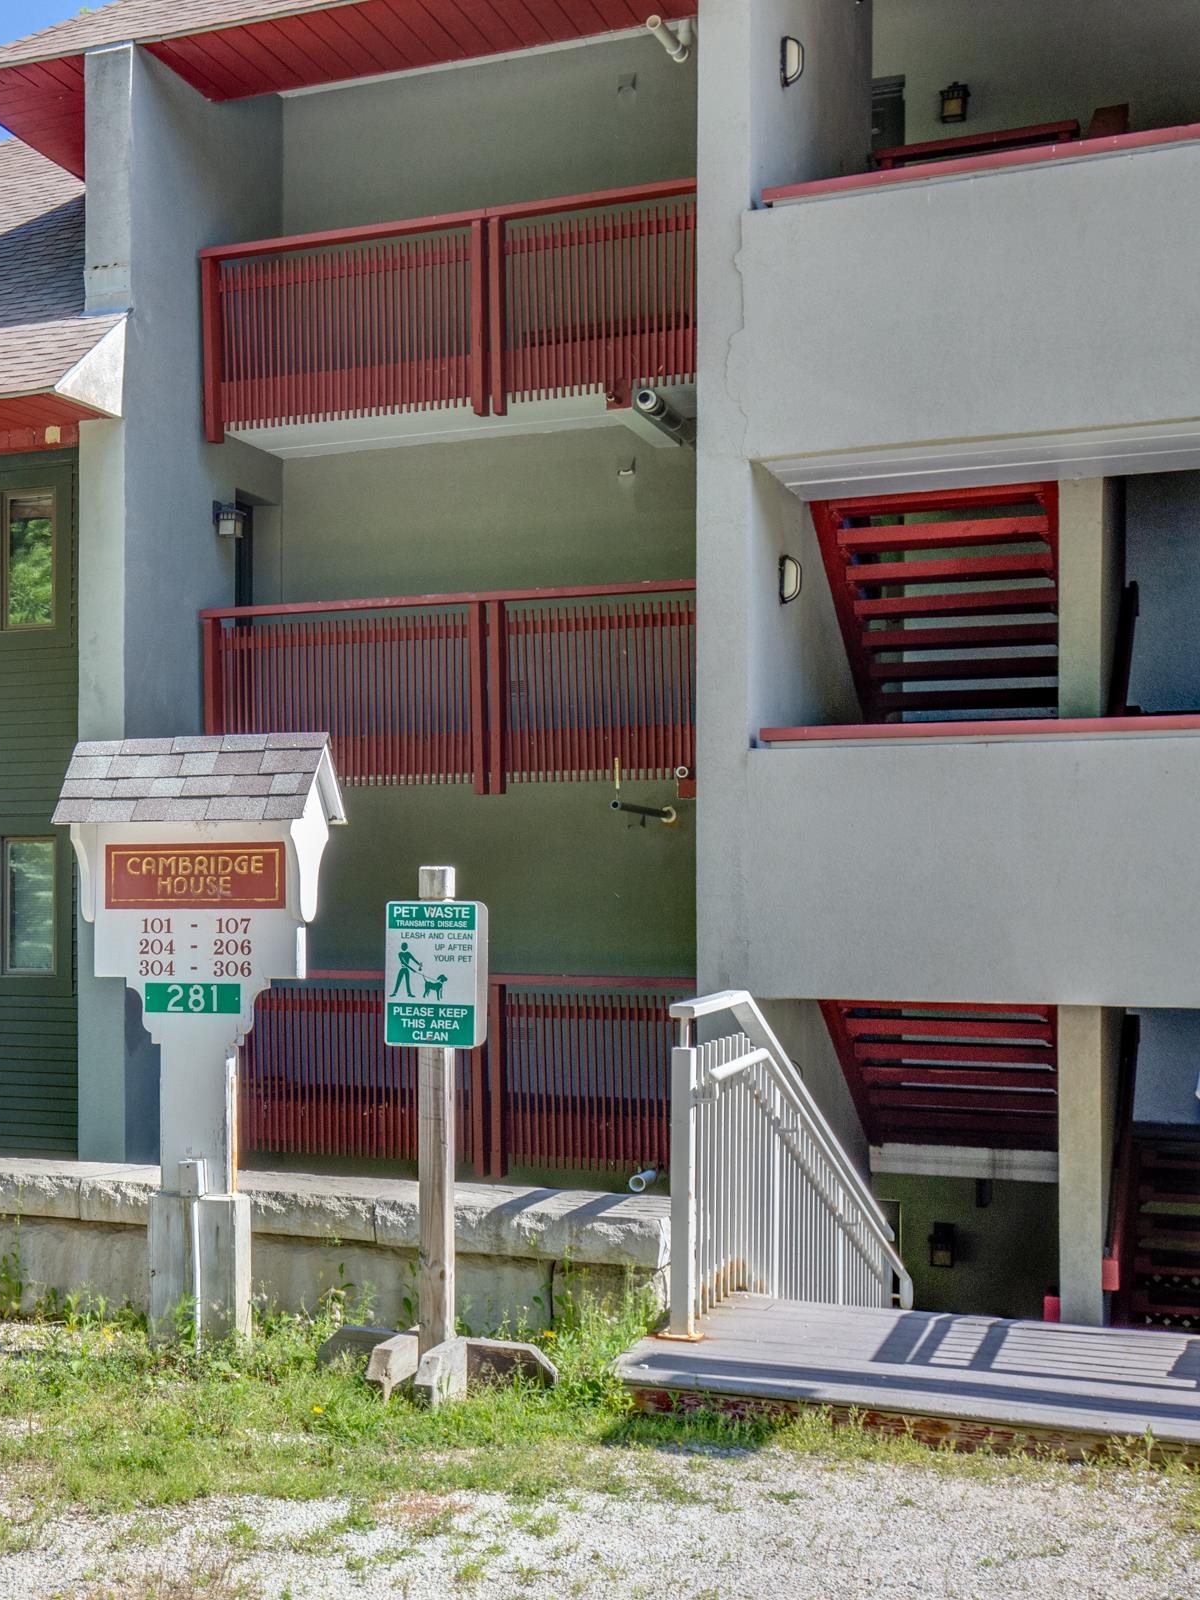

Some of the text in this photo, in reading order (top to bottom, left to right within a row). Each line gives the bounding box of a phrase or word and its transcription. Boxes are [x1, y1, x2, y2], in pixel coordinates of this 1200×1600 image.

[126, 855, 264, 876] CAMBRIDGE
[157, 876, 232, 896] HOUSE
[393, 907, 470, 918] PET WASTE
[141, 918, 173, 934] 101
[215, 918, 251, 934] 107
[139, 939, 175, 955] 204
[213, 939, 252, 956] 206
[139, 960, 175, 977] 304
[213, 960, 252, 978] 306
[166, 984, 219, 1012] 281
[393, 1007, 467, 1018] PLEASE KEEP
[401, 1019, 459, 1029] THIS AREA
[412, 1031, 448, 1041] CLEAN
